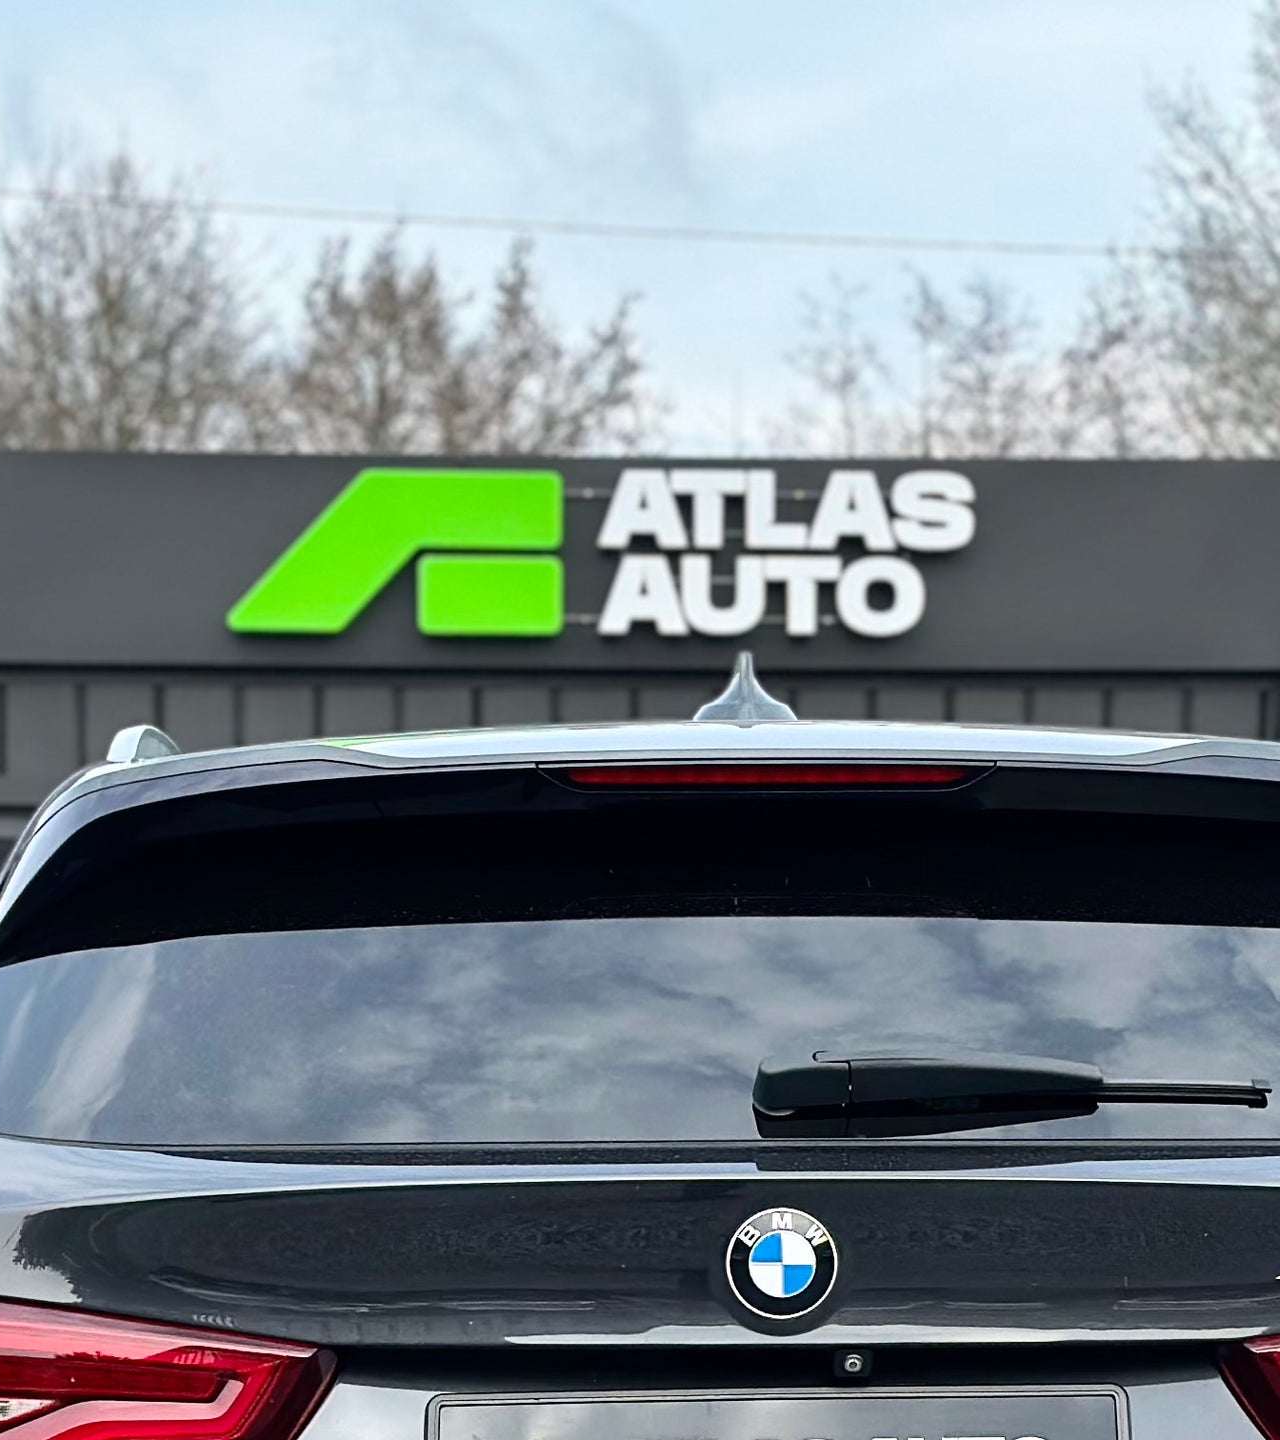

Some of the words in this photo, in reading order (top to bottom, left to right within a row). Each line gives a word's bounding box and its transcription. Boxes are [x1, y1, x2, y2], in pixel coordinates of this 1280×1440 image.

[597, 468, 977, 553] ATLAS
[597, 554, 927, 638] AUTO
[737, 1212, 829, 1248] BMW
